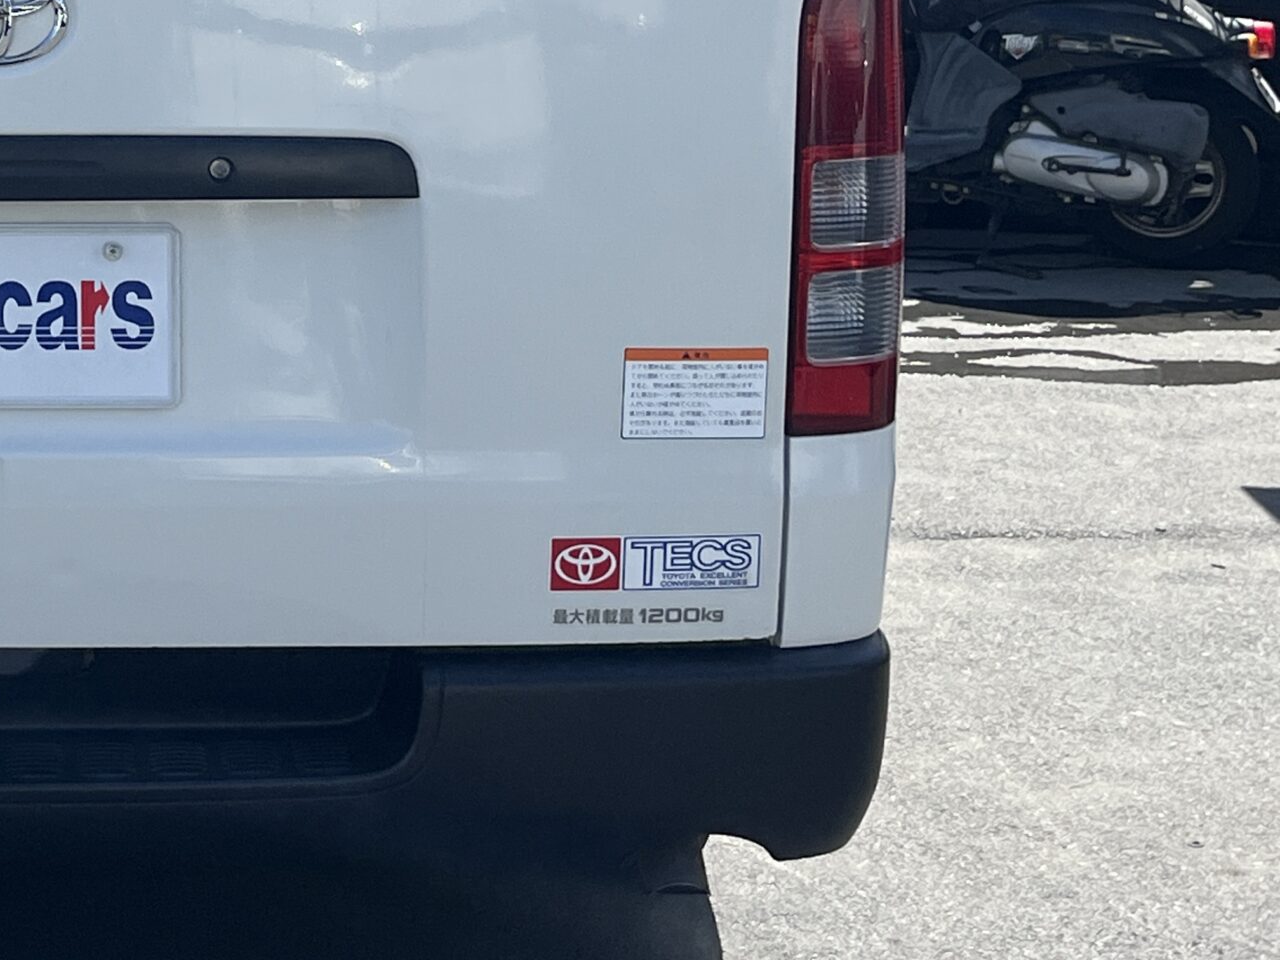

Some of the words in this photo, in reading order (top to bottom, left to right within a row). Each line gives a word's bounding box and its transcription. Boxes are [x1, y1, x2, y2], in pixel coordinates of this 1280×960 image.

[631, 539, 752, 586] TECS
[699, 571, 749, 579] EXCELLENT
[553, 608, 634, 625] 最大積載量
[639, 607, 724, 624] 1200kg
